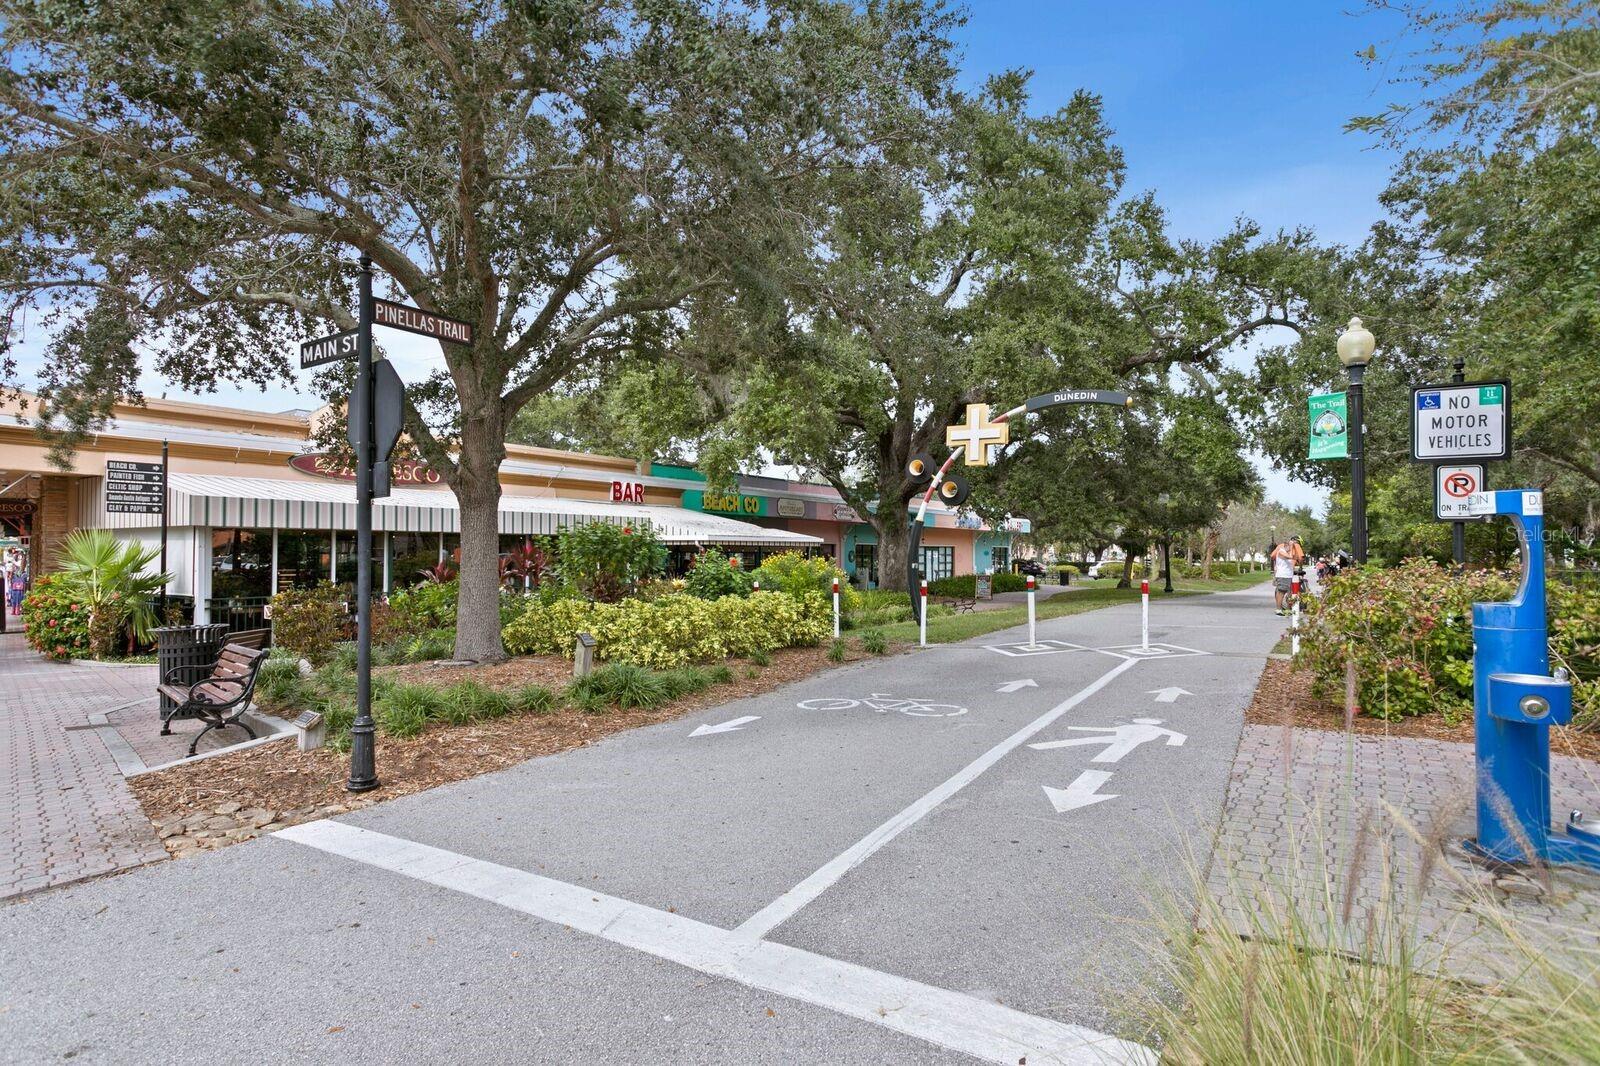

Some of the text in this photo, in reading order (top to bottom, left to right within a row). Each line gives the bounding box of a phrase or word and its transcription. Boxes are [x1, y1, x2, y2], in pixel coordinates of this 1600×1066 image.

[375, 303, 469, 342] PINELLAS TRAIL
[303, 333, 359, 363] MAIN ST
[1054, 392, 1098, 402] DUNEDIN
[1327, 399, 1345, 408] Trail
[1448, 396, 1470, 410] NO
[1431, 415, 1488, 430] MOTOR
[1428, 433, 1492, 448] VEHICLES
[611, 481, 644, 503] BAR
[703, 494, 740, 512] BEACH
[744, 496, 760, 513] CO
